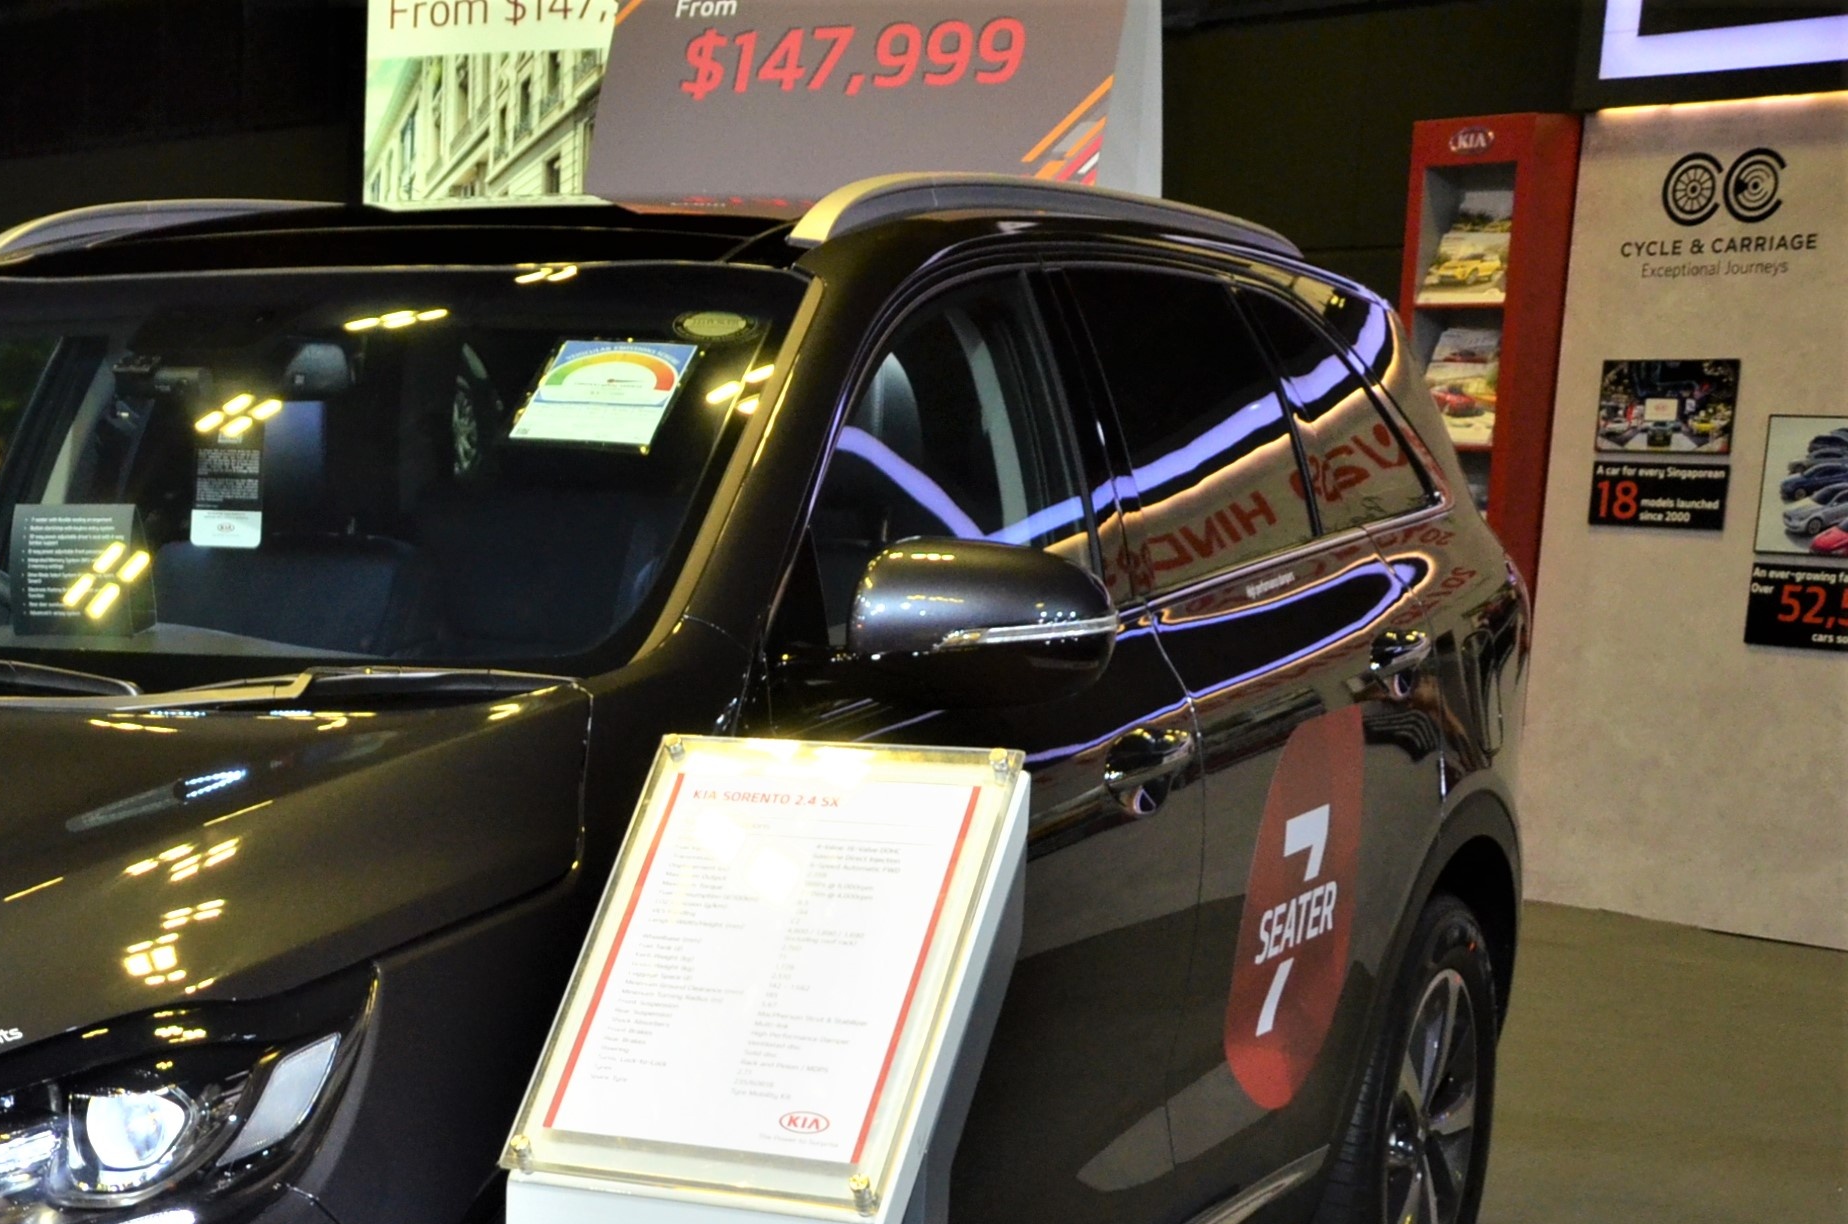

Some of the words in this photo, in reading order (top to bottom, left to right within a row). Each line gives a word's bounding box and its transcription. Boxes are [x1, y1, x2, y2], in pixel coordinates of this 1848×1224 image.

[390, 0, 488, 29] From
[675, 0, 737, 18] From
[679, 16, 1026, 100] $147,999
[1456, 133, 1488, 150] KIA
[1620, 239, 1683, 257] CYCLE
[1689, 238, 1704, 255] &
[1711, 233, 1819, 254] CARRIAGE
[1641, 260, 1722, 279] Exceptional
[1725, 260, 1790, 276] Journeys
[1596, 465, 1605, 475] A
[1605, 467, 1620, 477] car
[1622, 465, 1637, 477] for
[1638, 468, 1665, 479] every
[1666, 467, 1726, 480] Singaporean
[1597, 479, 1639, 520] 18
[1640, 497, 1674, 509] models
[1676, 498, 1720, 510] launched
[1639, 511, 1664, 521] since
[1665, 511, 1691, 523] 2000
[1752, 567, 1767, 578] An
[1768, 569, 1837, 584] ever-growing
[1751, 582, 1775, 593] Over
[1811, 633, 1834, 643] cars
[693, 789, 717, 800] KIA
[722, 790, 791, 806] SORENTO
[794, 794, 817, 806] 2.4
[821, 796, 841, 808] SX
[1254, 880, 1338, 965] SEATER
[786, 1114, 821, 1131] KIA
